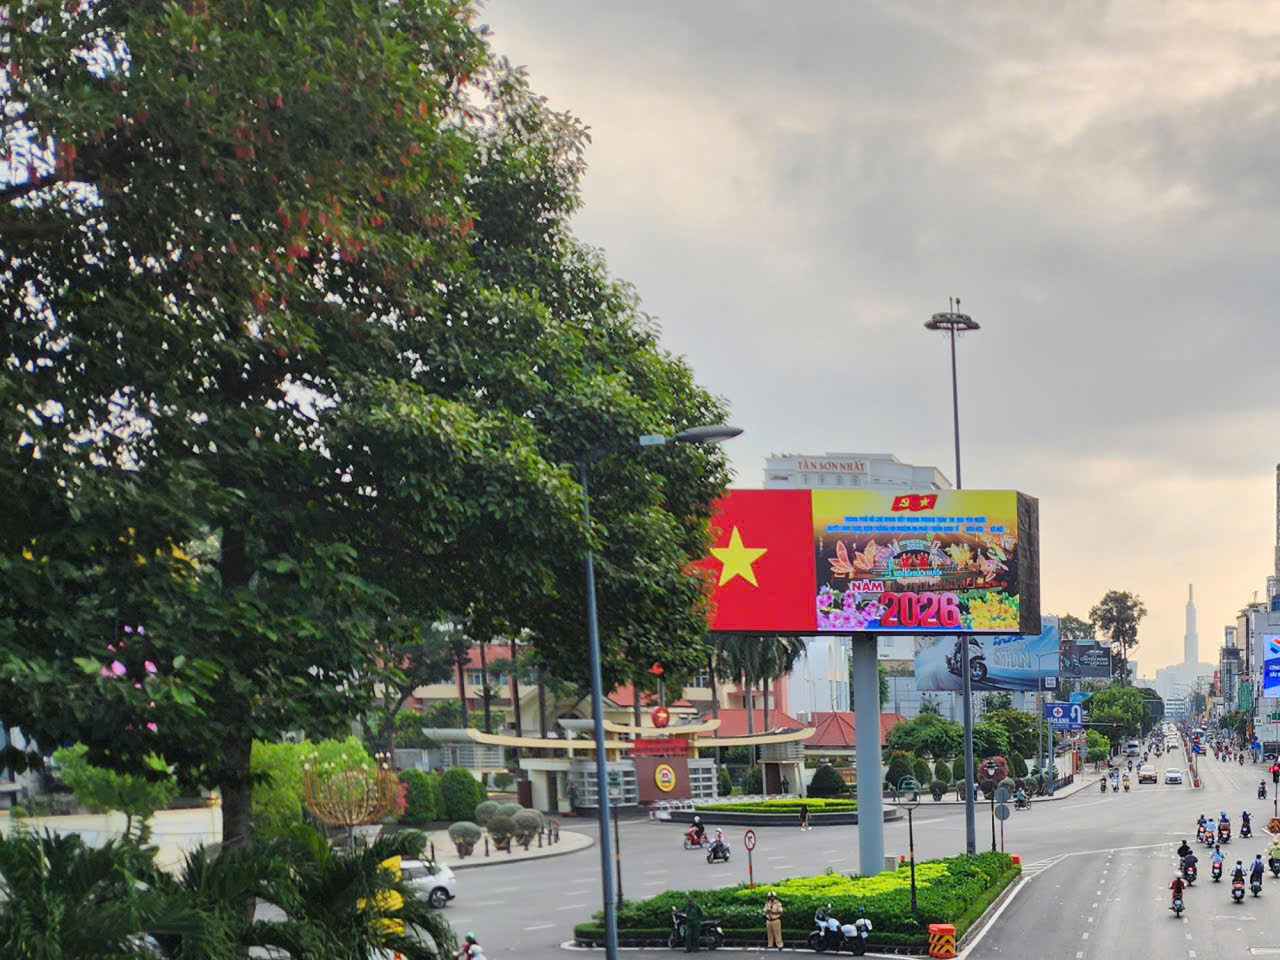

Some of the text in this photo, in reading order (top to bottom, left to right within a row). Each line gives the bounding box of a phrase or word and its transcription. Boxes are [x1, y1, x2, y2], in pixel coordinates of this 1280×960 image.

[797, 459, 865, 471] TÂN SƠN NHẤT
[851, 579, 885, 593] NĂM
[880, 591, 961, 627] 2026
